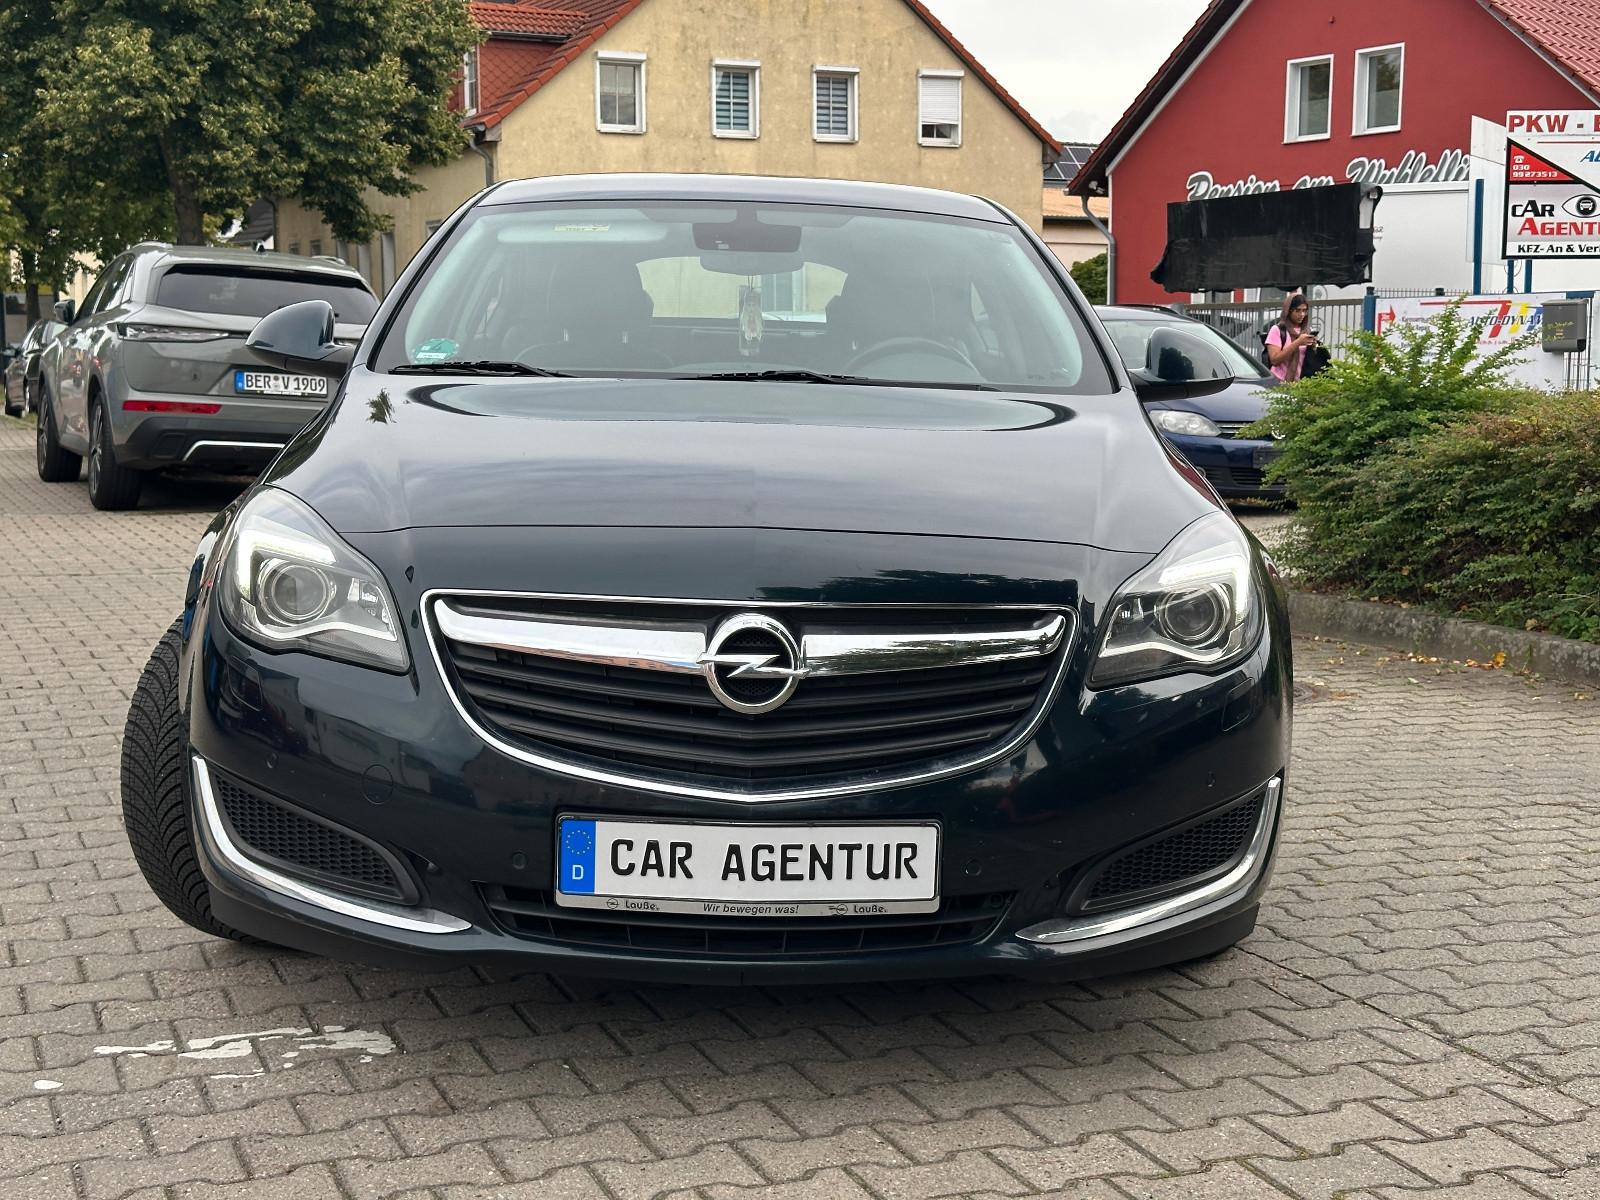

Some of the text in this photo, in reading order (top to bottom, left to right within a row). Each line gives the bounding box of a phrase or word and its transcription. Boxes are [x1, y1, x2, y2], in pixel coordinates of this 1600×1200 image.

[1508, 115, 1569, 133] PKW
[1517, 217, 1600, 236] AGENT
[1517, 244, 1600, 253] KFZ- An & Ver
[245, 374, 325, 392] BER V 1909
[610, 838, 919, 882] CAR AGENTUR
[571, 864, 585, 881] D
[703, 903, 799, 915] Wir bewegen was!
